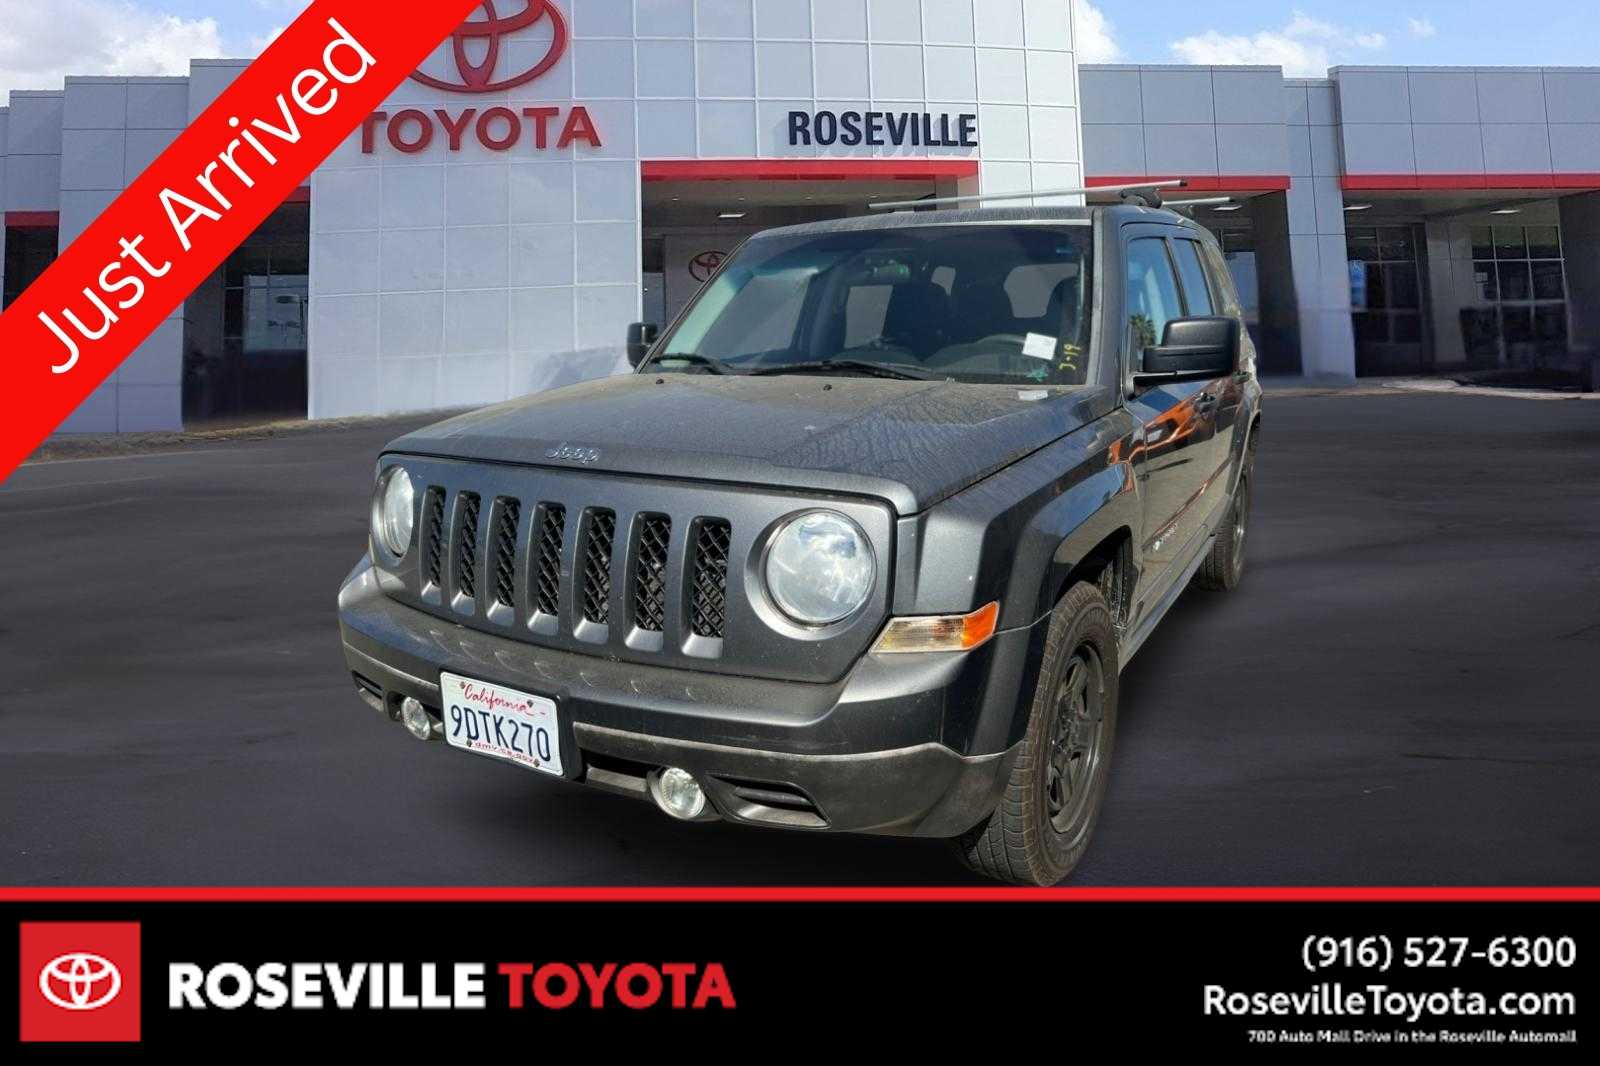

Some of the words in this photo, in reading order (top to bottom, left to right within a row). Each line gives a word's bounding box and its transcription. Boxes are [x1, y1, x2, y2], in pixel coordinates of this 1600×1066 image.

[361, 106, 602, 154] TOYOTA
[788, 111, 978, 147] ROSEVILLE
[545, 446, 600, 464] Jeep
[464, 683, 534, 716] California
[450, 704, 551, 762] 9DTK270
